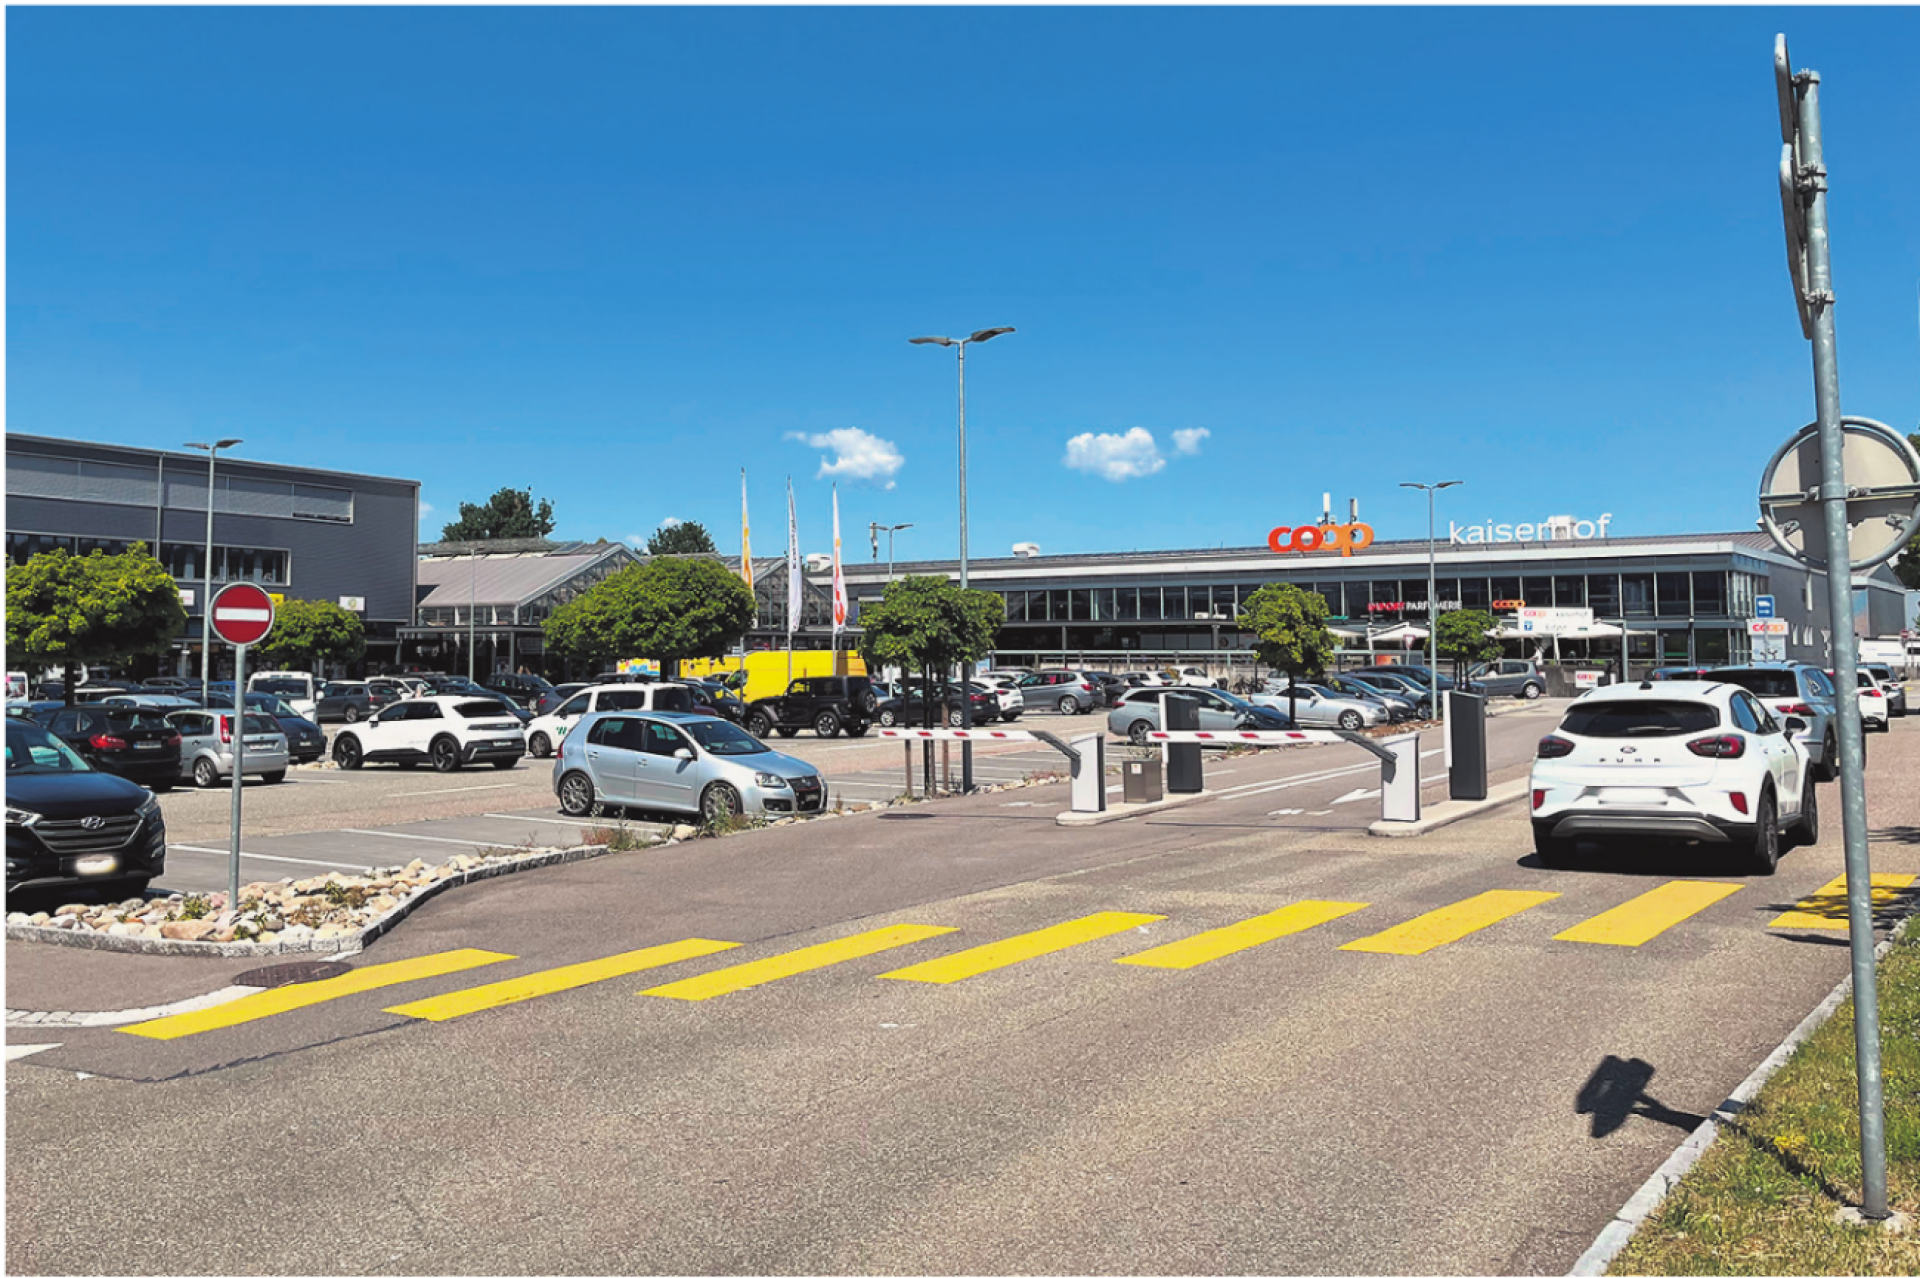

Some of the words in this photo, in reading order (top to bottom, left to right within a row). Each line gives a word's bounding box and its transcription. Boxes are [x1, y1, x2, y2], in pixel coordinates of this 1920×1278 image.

[1267, 522, 1375, 557] coop
[1449, 512, 1613, 545] kaiserhof
[1492, 600, 1526, 611] coop
